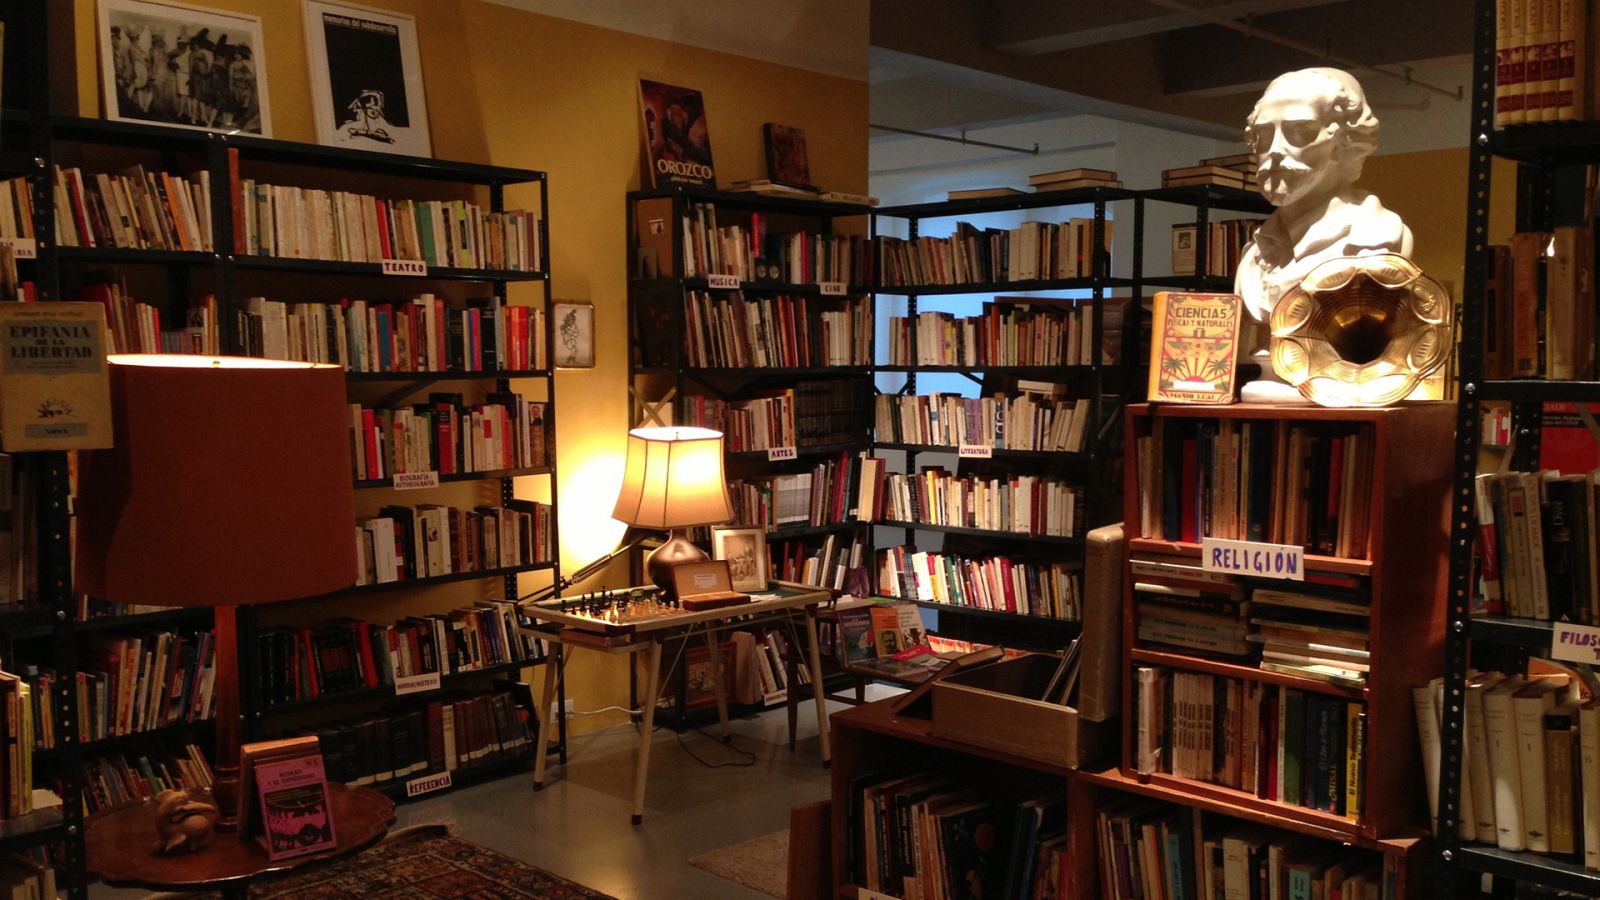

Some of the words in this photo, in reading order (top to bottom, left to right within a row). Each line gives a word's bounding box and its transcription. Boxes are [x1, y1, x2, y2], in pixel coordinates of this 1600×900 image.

[657, 159, 712, 179] OROZCO
[384, 263, 424, 273] TEATRO
[710, 278, 739, 287] MUSICA
[825, 285, 841, 293] CINE
[1175, 306, 1227, 318] CIENCIAS
[1197, 320, 1233, 328] NATURALES
[10, 326, 92, 338] EPIFANIA
[11, 346, 93, 358] LIBERTAD
[771, 449, 794, 458] ARTES
[1212, 547, 1297, 574] RELIGIÓN
[1560, 631, 1600, 646] FILOS
[409, 775, 450, 794] REFERENCIA
[1328, 763, 1338, 801] MISAL
